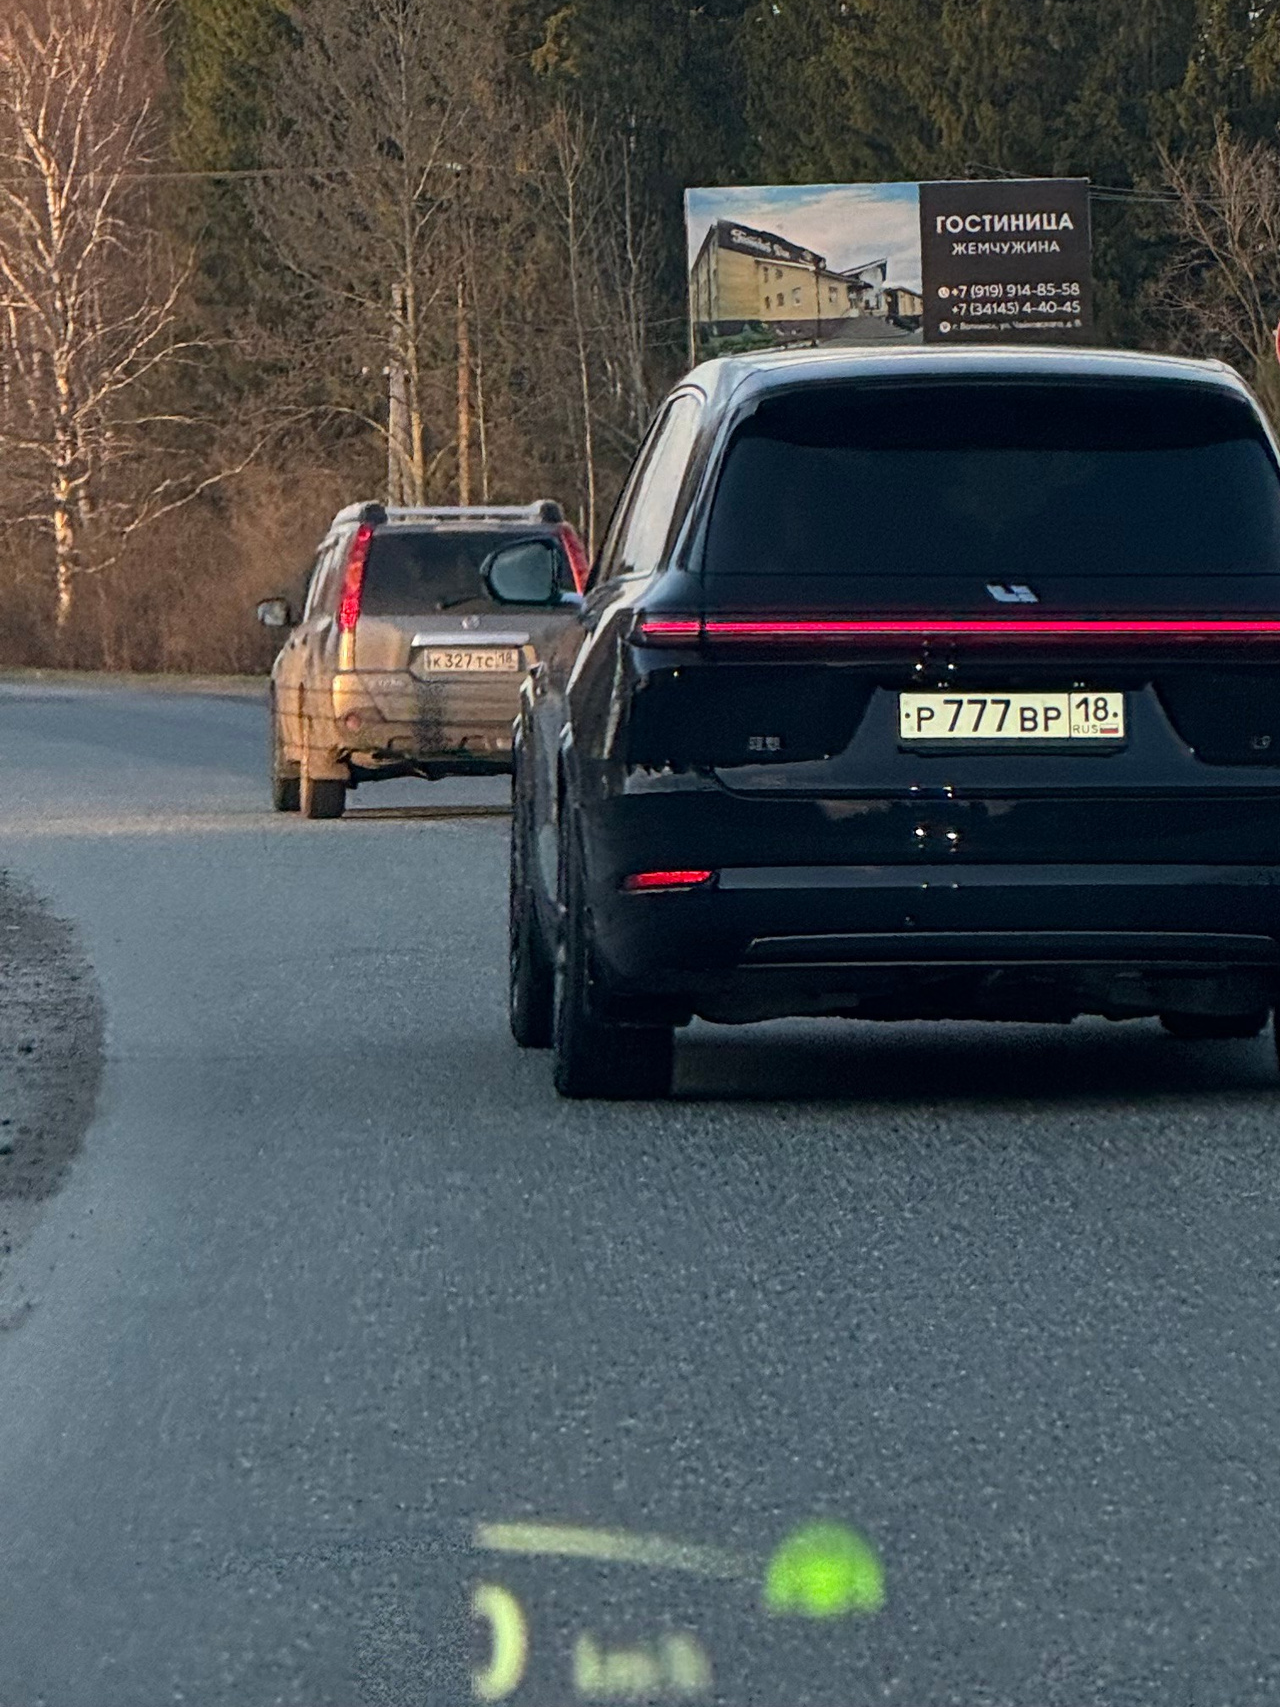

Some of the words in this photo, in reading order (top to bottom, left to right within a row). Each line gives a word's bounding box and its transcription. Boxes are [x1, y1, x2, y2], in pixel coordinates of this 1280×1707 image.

[935, 212, 1074, 234] ГОСТИНИЦА
[951, 240, 1061, 255] ЖЕМЧУЖИНА
[951, 285, 968, 298] +7
[970, 283, 1003, 299] (919)
[1006, 282, 1080, 296] 914-85-58
[951, 303, 967, 316] +7
[969, 301, 1019, 316] (34145)
[1021, 300, 1081, 313] 4-40-45
[1075, 696, 1109, 722] 18
[1072, 724, 1099, 734] RUS
